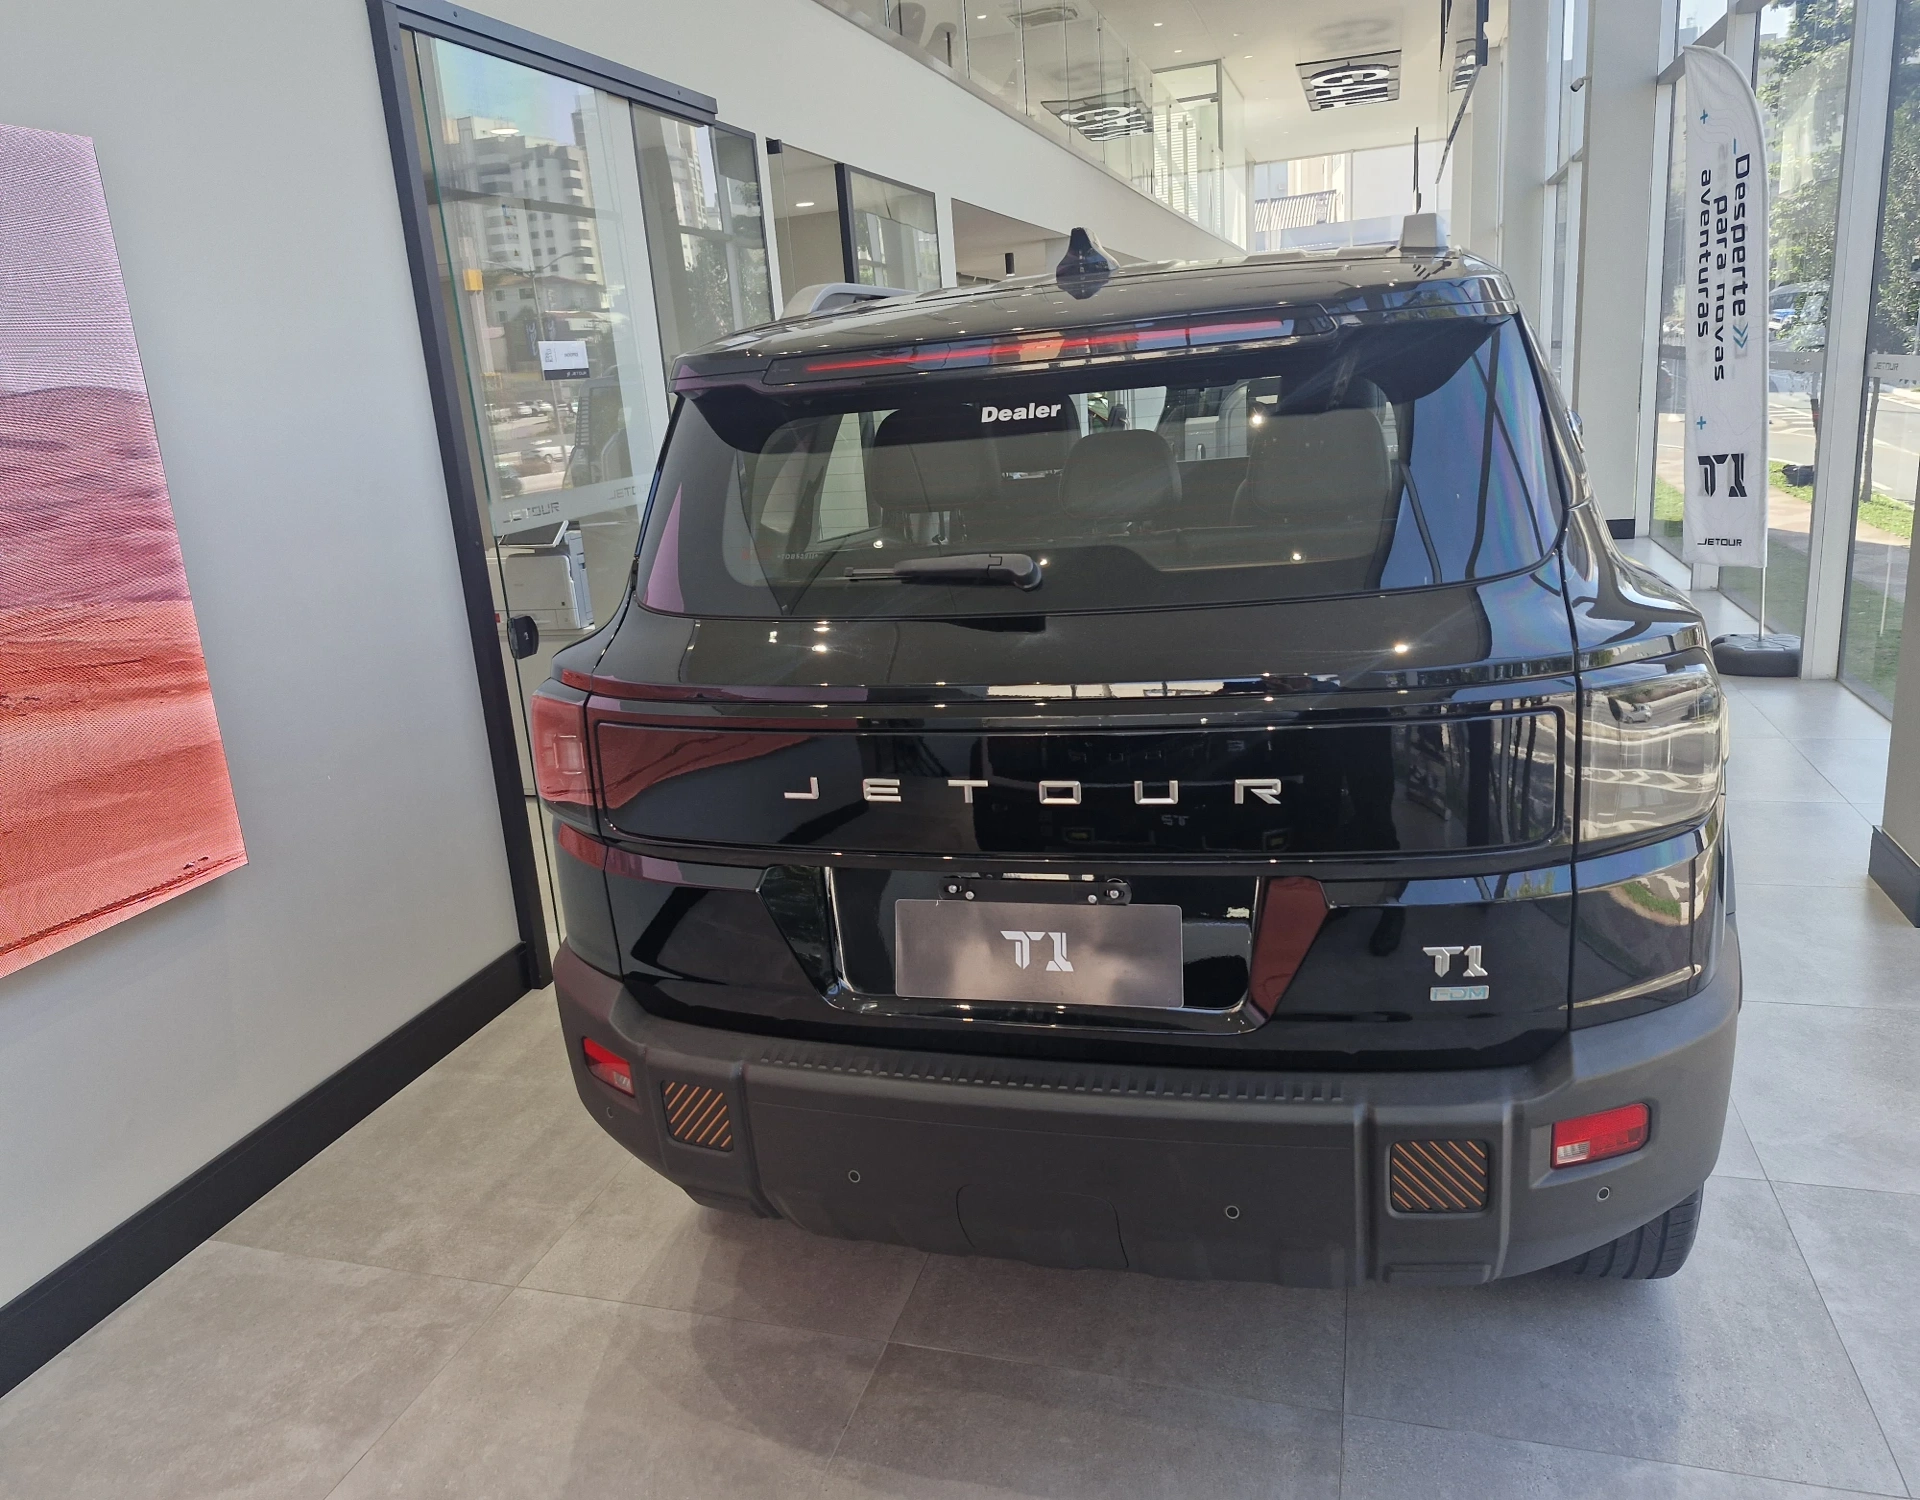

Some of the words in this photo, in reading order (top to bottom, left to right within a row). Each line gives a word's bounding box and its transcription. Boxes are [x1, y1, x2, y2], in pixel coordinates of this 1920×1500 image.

[1697, 169, 1712, 337] aventuras
[1713, 195, 1728, 270] para
[1731, 153, 1750, 317] Desperte
[1714, 283, 1726, 381] novas
[981, 402, 1062, 423] Dealer
[1697, 453, 1747, 497] T1
[502, 501, 560, 524] JETOUR
[1697, 538, 1742, 546] JETOUR
[784, 776, 1282, 805] JETOUR
[1000, 930, 1074, 973] T1
[1422, 945, 1488, 978] T1
